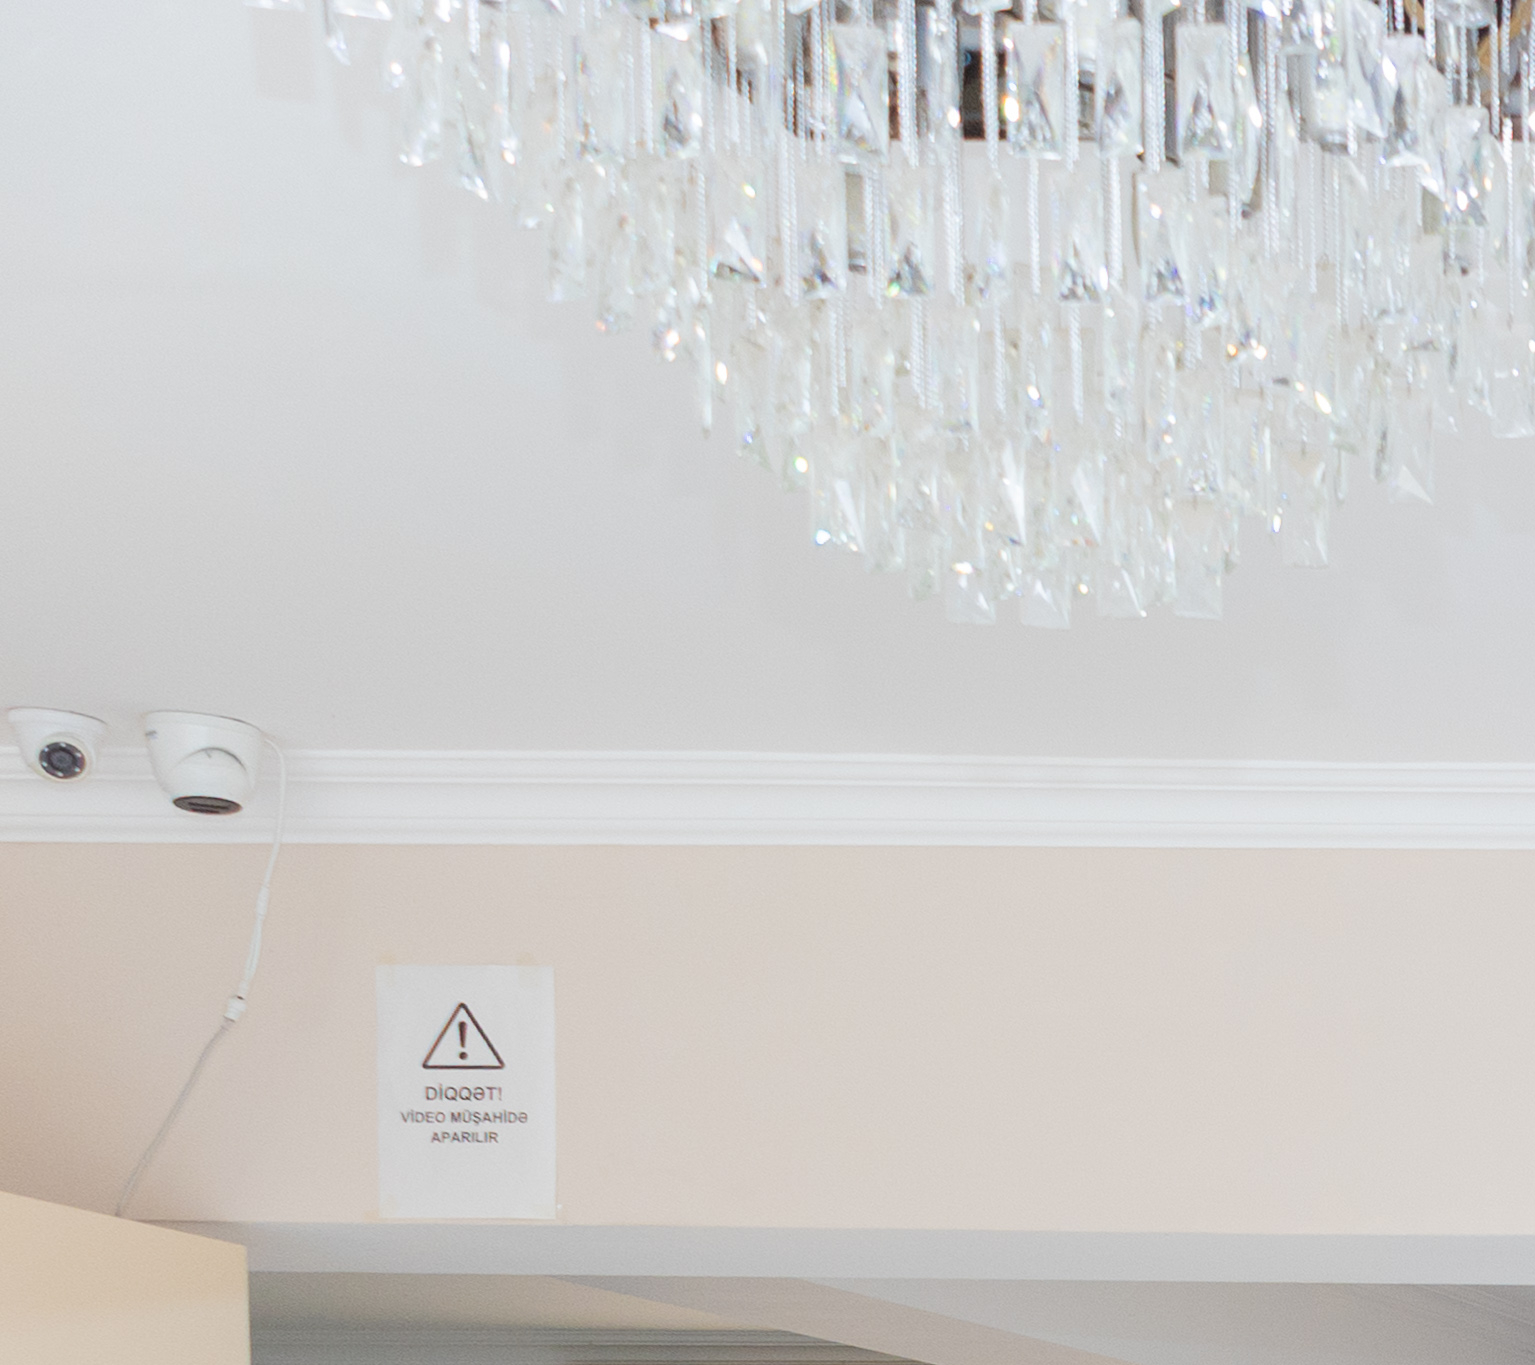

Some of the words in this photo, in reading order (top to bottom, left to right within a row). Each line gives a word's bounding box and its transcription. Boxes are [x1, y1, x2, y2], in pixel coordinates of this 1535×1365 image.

[425, 1083, 502, 1101] DİQQƏT!
[401, 1109, 446, 1123] VİDEO
[450, 1109, 528, 1125] MÜŞAHİDƏ
[431, 1132, 499, 1143] APARILIR
